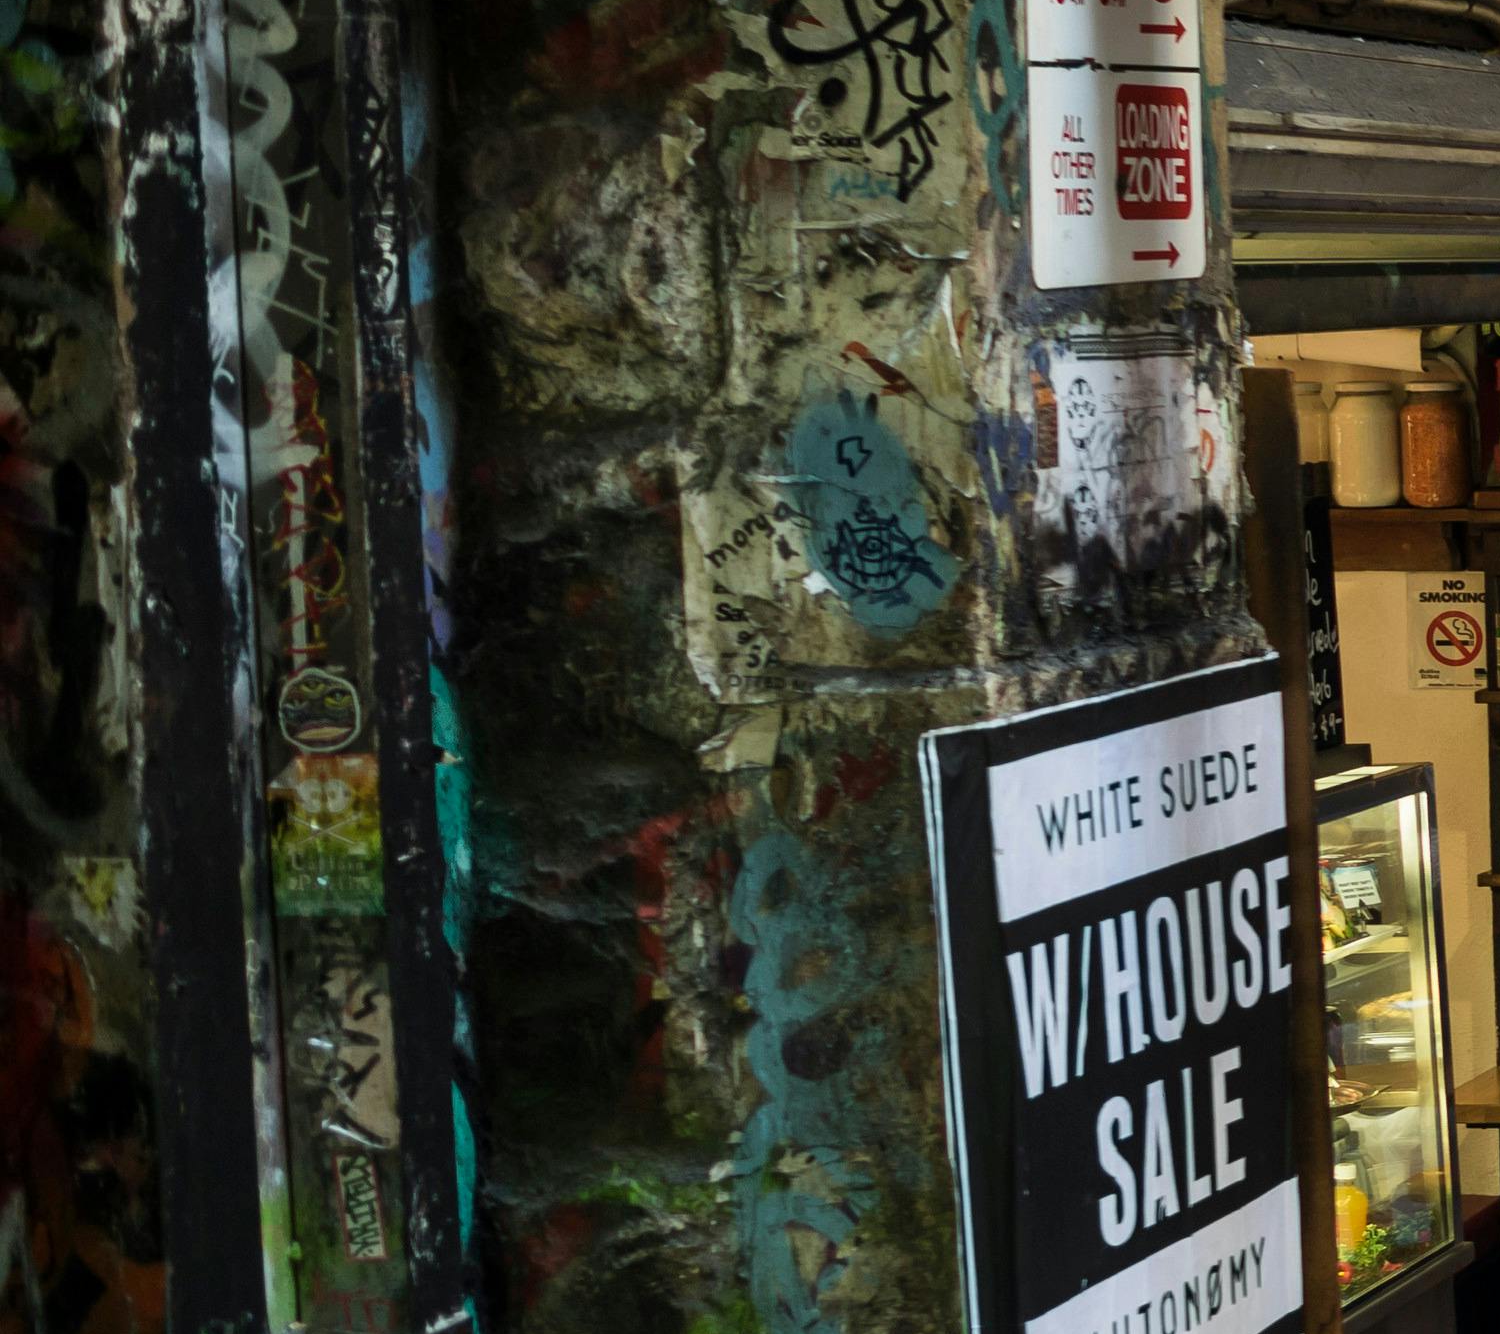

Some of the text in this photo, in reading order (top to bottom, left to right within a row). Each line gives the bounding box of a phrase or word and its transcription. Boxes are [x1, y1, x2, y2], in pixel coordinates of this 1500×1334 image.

[1060, 101, 1189, 152] ALL LOADING
[1050, 150, 1188, 204] OTHER ZONE
[1054, 187, 1094, 217] TIMES
[1419, 591, 1487, 604] SMOKING
[1442, 579, 1466, 591] NO
[1036, 742, 1259, 857] WHITE SUEDE
[1005, 854, 1293, 1100] W/HOUSE
[1096, 1045, 1248, 1248] SALE
